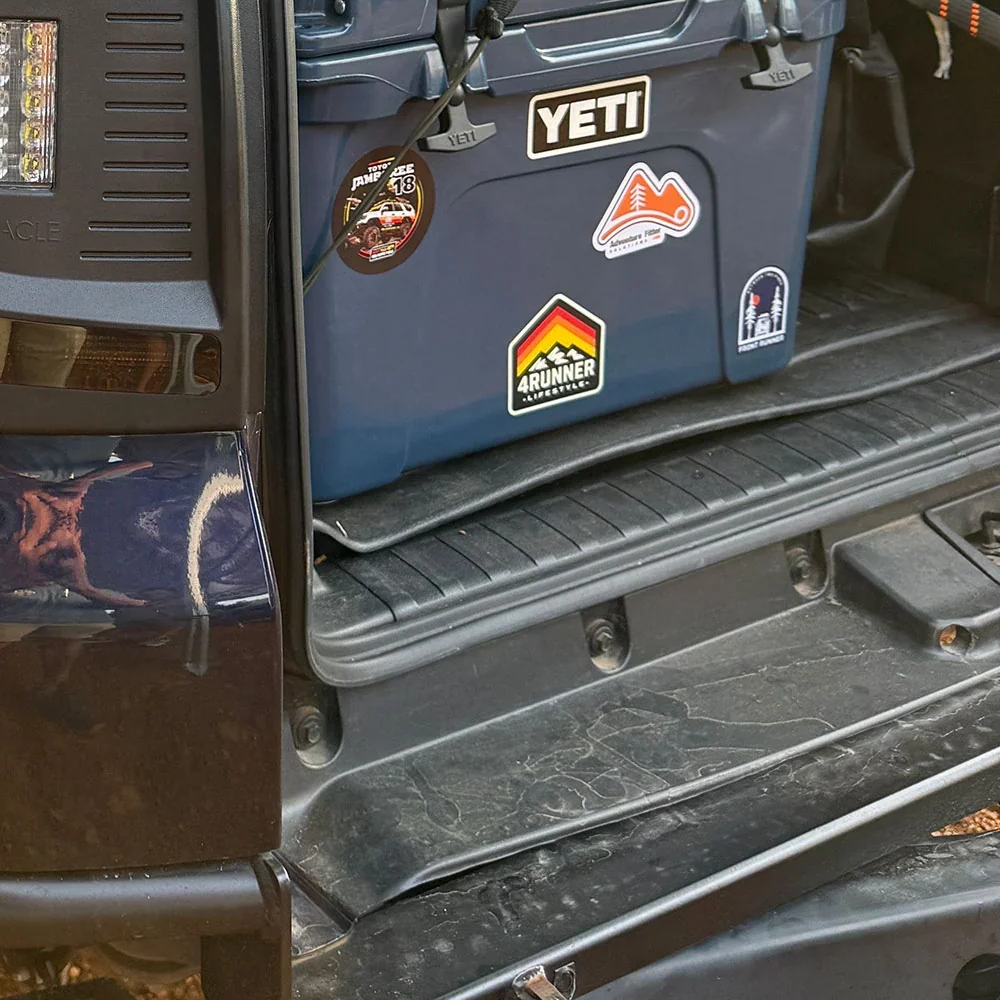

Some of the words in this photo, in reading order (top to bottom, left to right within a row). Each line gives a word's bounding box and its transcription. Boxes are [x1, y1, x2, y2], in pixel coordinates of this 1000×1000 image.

[769, 69, 796, 83] YETI
[537, 90, 639, 144] YETI
[448, 129, 476, 147] YETI
[367, 161, 392, 173] TOYO
[393, 174, 417, 196] 18
[517, 358, 596, 394] 4RUNNER
[526, 380, 585, 402] LIFESTYLE
